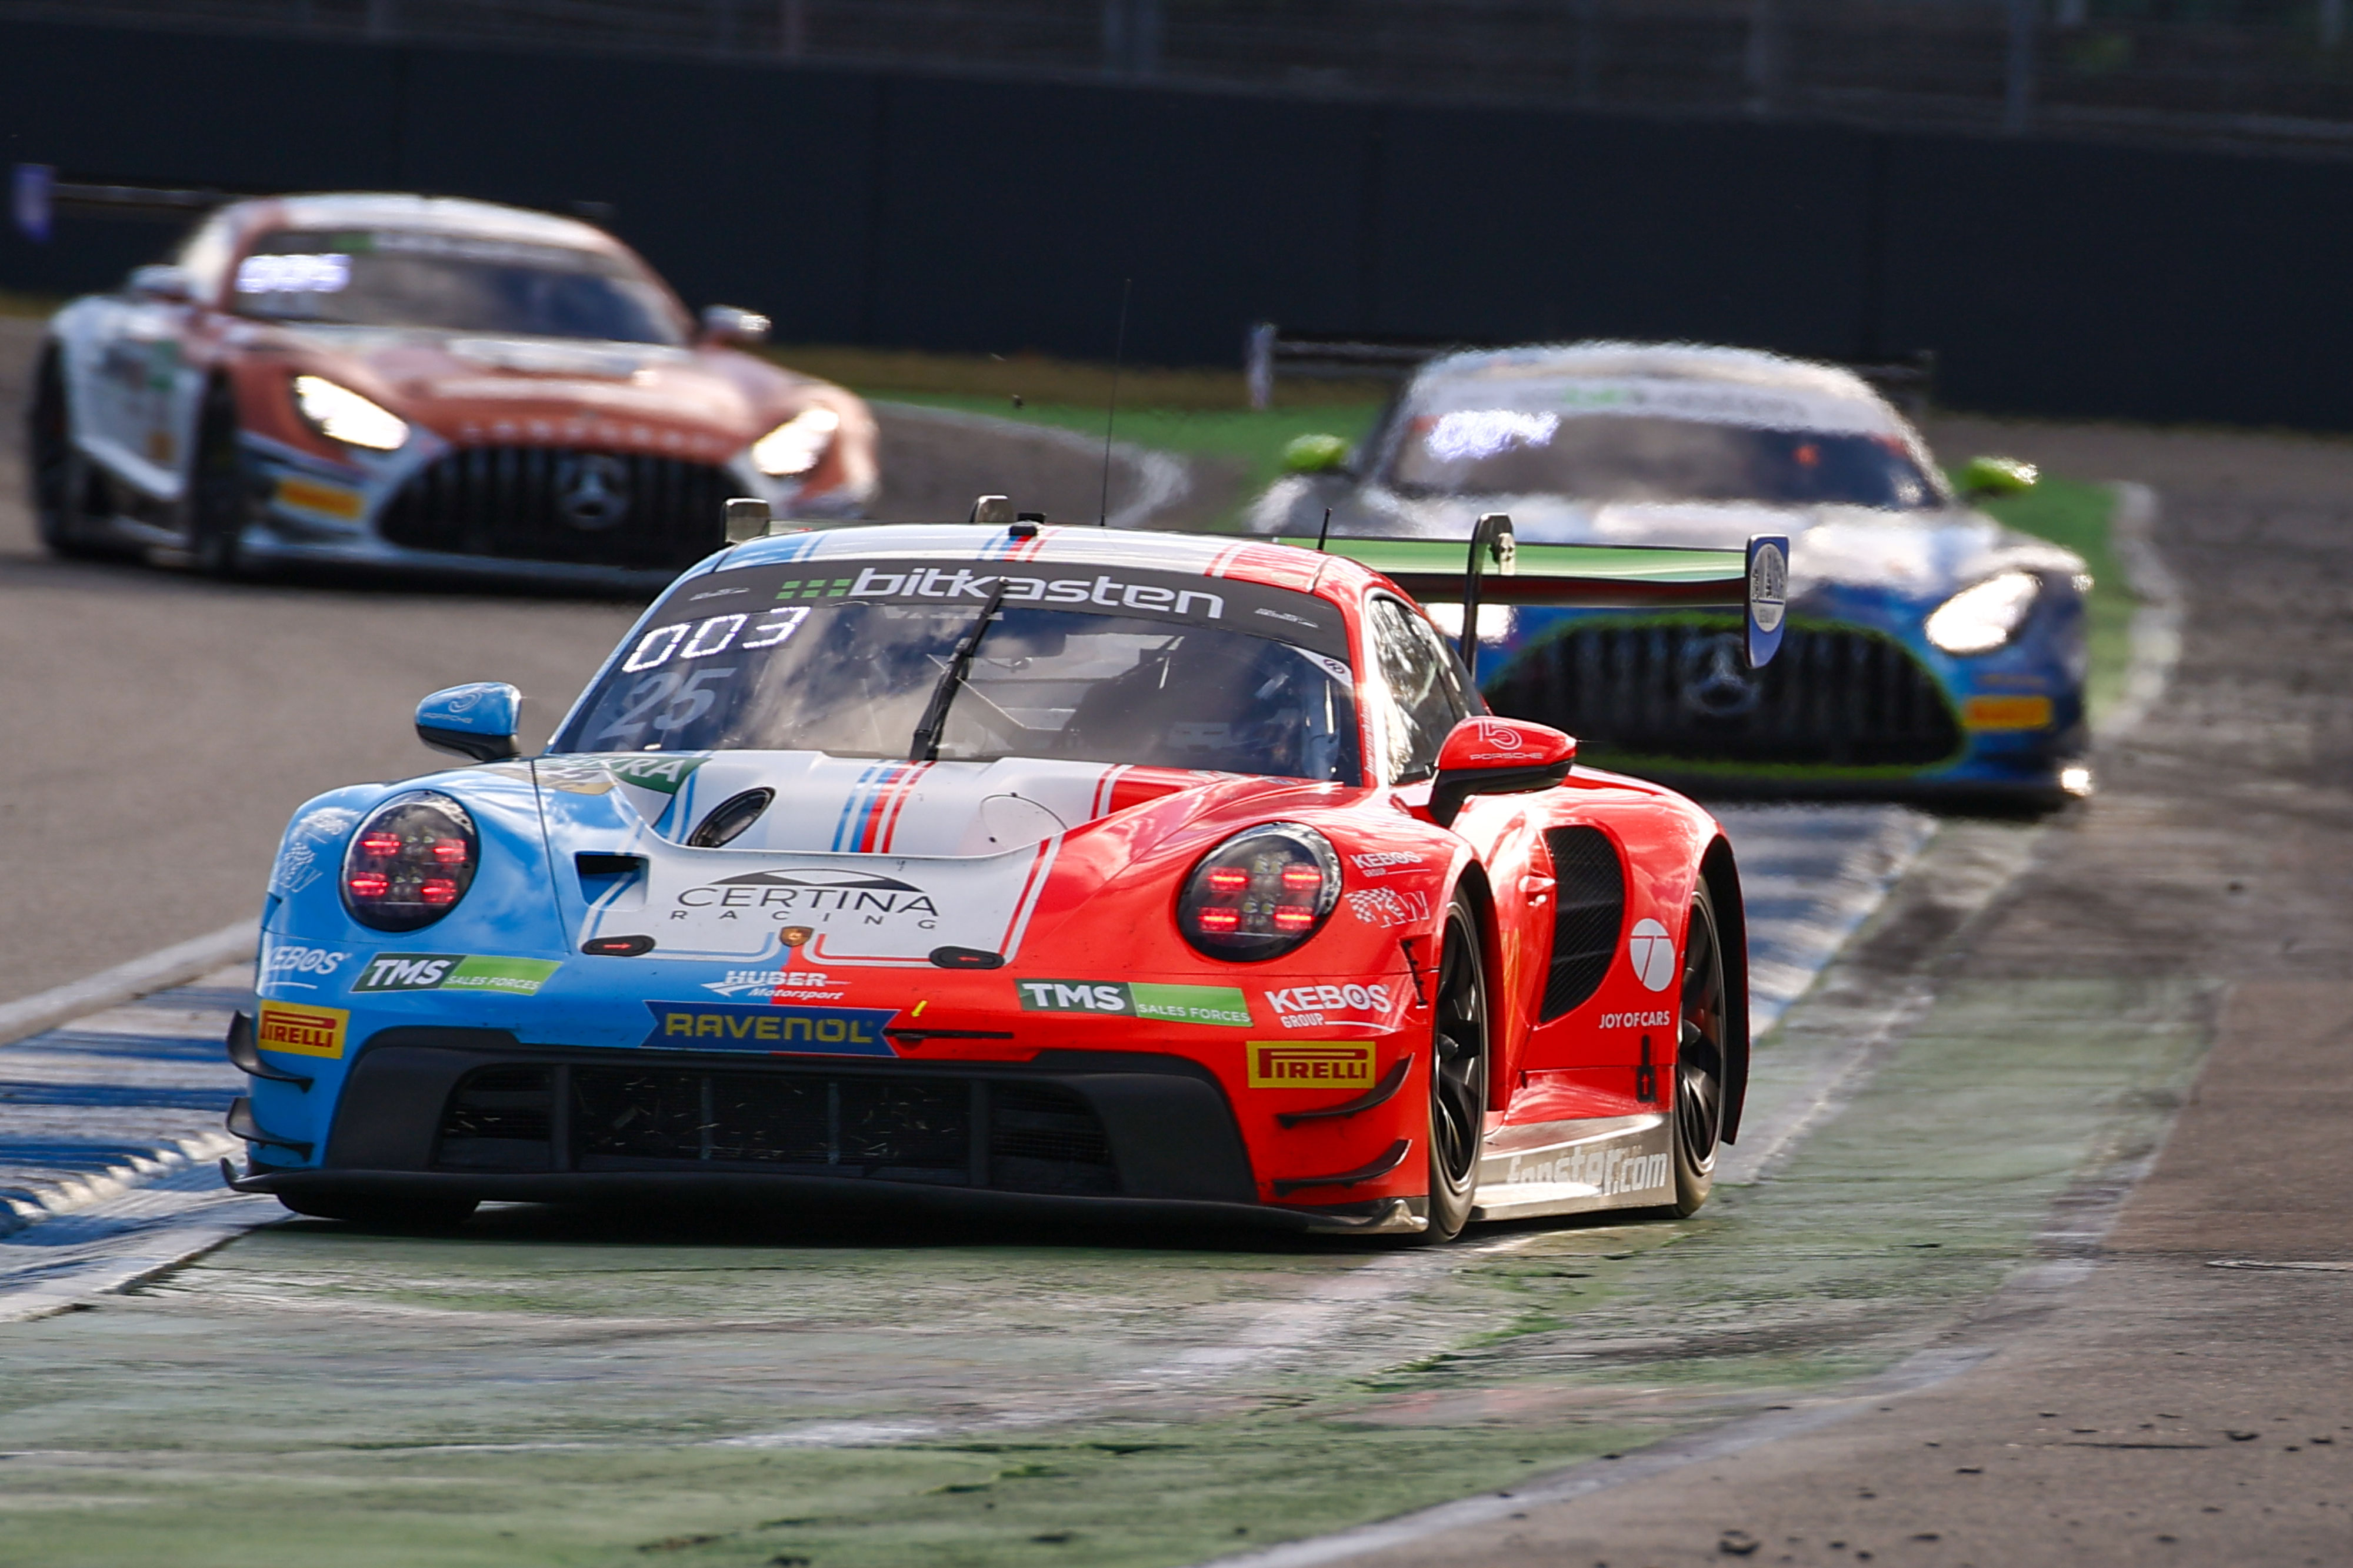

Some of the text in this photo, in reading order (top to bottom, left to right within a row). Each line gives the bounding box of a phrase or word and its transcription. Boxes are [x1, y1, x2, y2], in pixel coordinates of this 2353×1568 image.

[849, 568, 1224, 619] bitkasten
[622, 606, 811, 673] 003
[597, 667, 738, 740] 25
[1470, 752, 1544, 760] PORSCHE
[1349, 851, 1423, 869] KEBOS
[677, 887, 939, 917] CERTINA
[669, 910, 938, 929] RACING
[271, 946, 342, 975] EBOS
[366, 959, 452, 986] TMS
[446, 975, 541, 990] SALES FORCES
[724, 970, 828, 987] HUBER
[748, 987, 845, 1000] Motorsport
[1022, 983, 1126, 1011] TMS
[1264, 983, 1392, 1013] KEBOS
[1139, 1003, 1251, 1023] SALES FORCES
[1280, 1013, 1324, 1029] GROUP
[261, 1010, 336, 1048] PIRELLI
[665, 1013, 874, 1043] RAVENOL
[1258, 1048, 1368, 1079] PIRELLI
